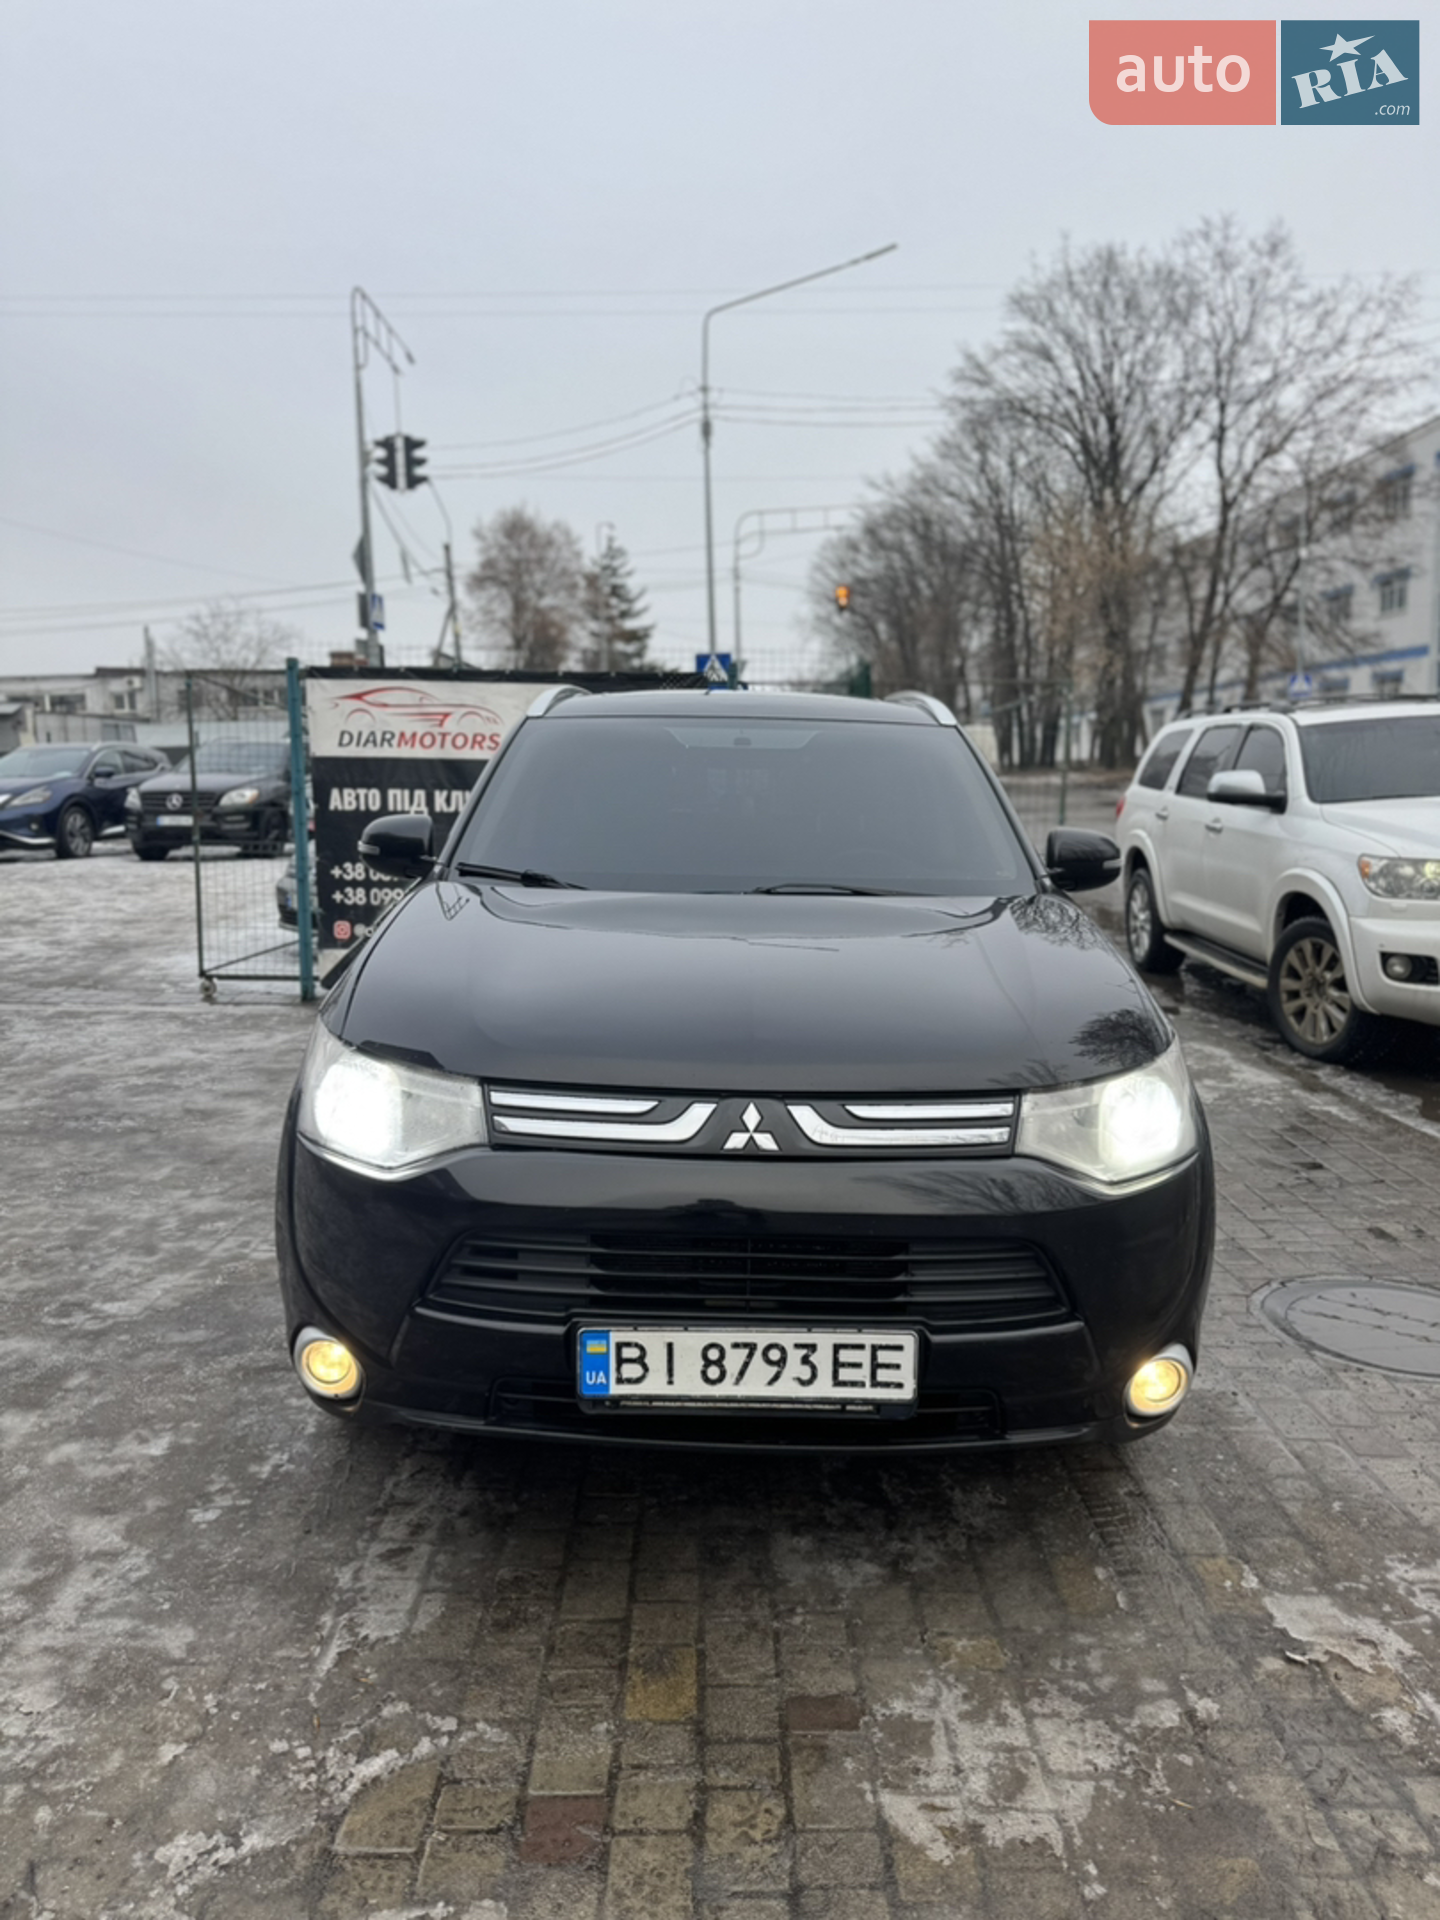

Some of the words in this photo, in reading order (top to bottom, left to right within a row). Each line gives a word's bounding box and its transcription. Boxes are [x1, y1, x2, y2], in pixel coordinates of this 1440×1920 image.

[337, 729, 501, 751] DIARMOTORS
[329, 787, 381, 812] АВТО
[387, 788, 429, 815] ПІД
[330, 861, 366, 881] +38
[331, 886, 367, 905] +38
[586, 1370, 607, 1386] UA
[614, 1341, 674, 1385] BI
[700, 1342, 818, 1388] 8793
[832, 1343, 905, 1389] EE
